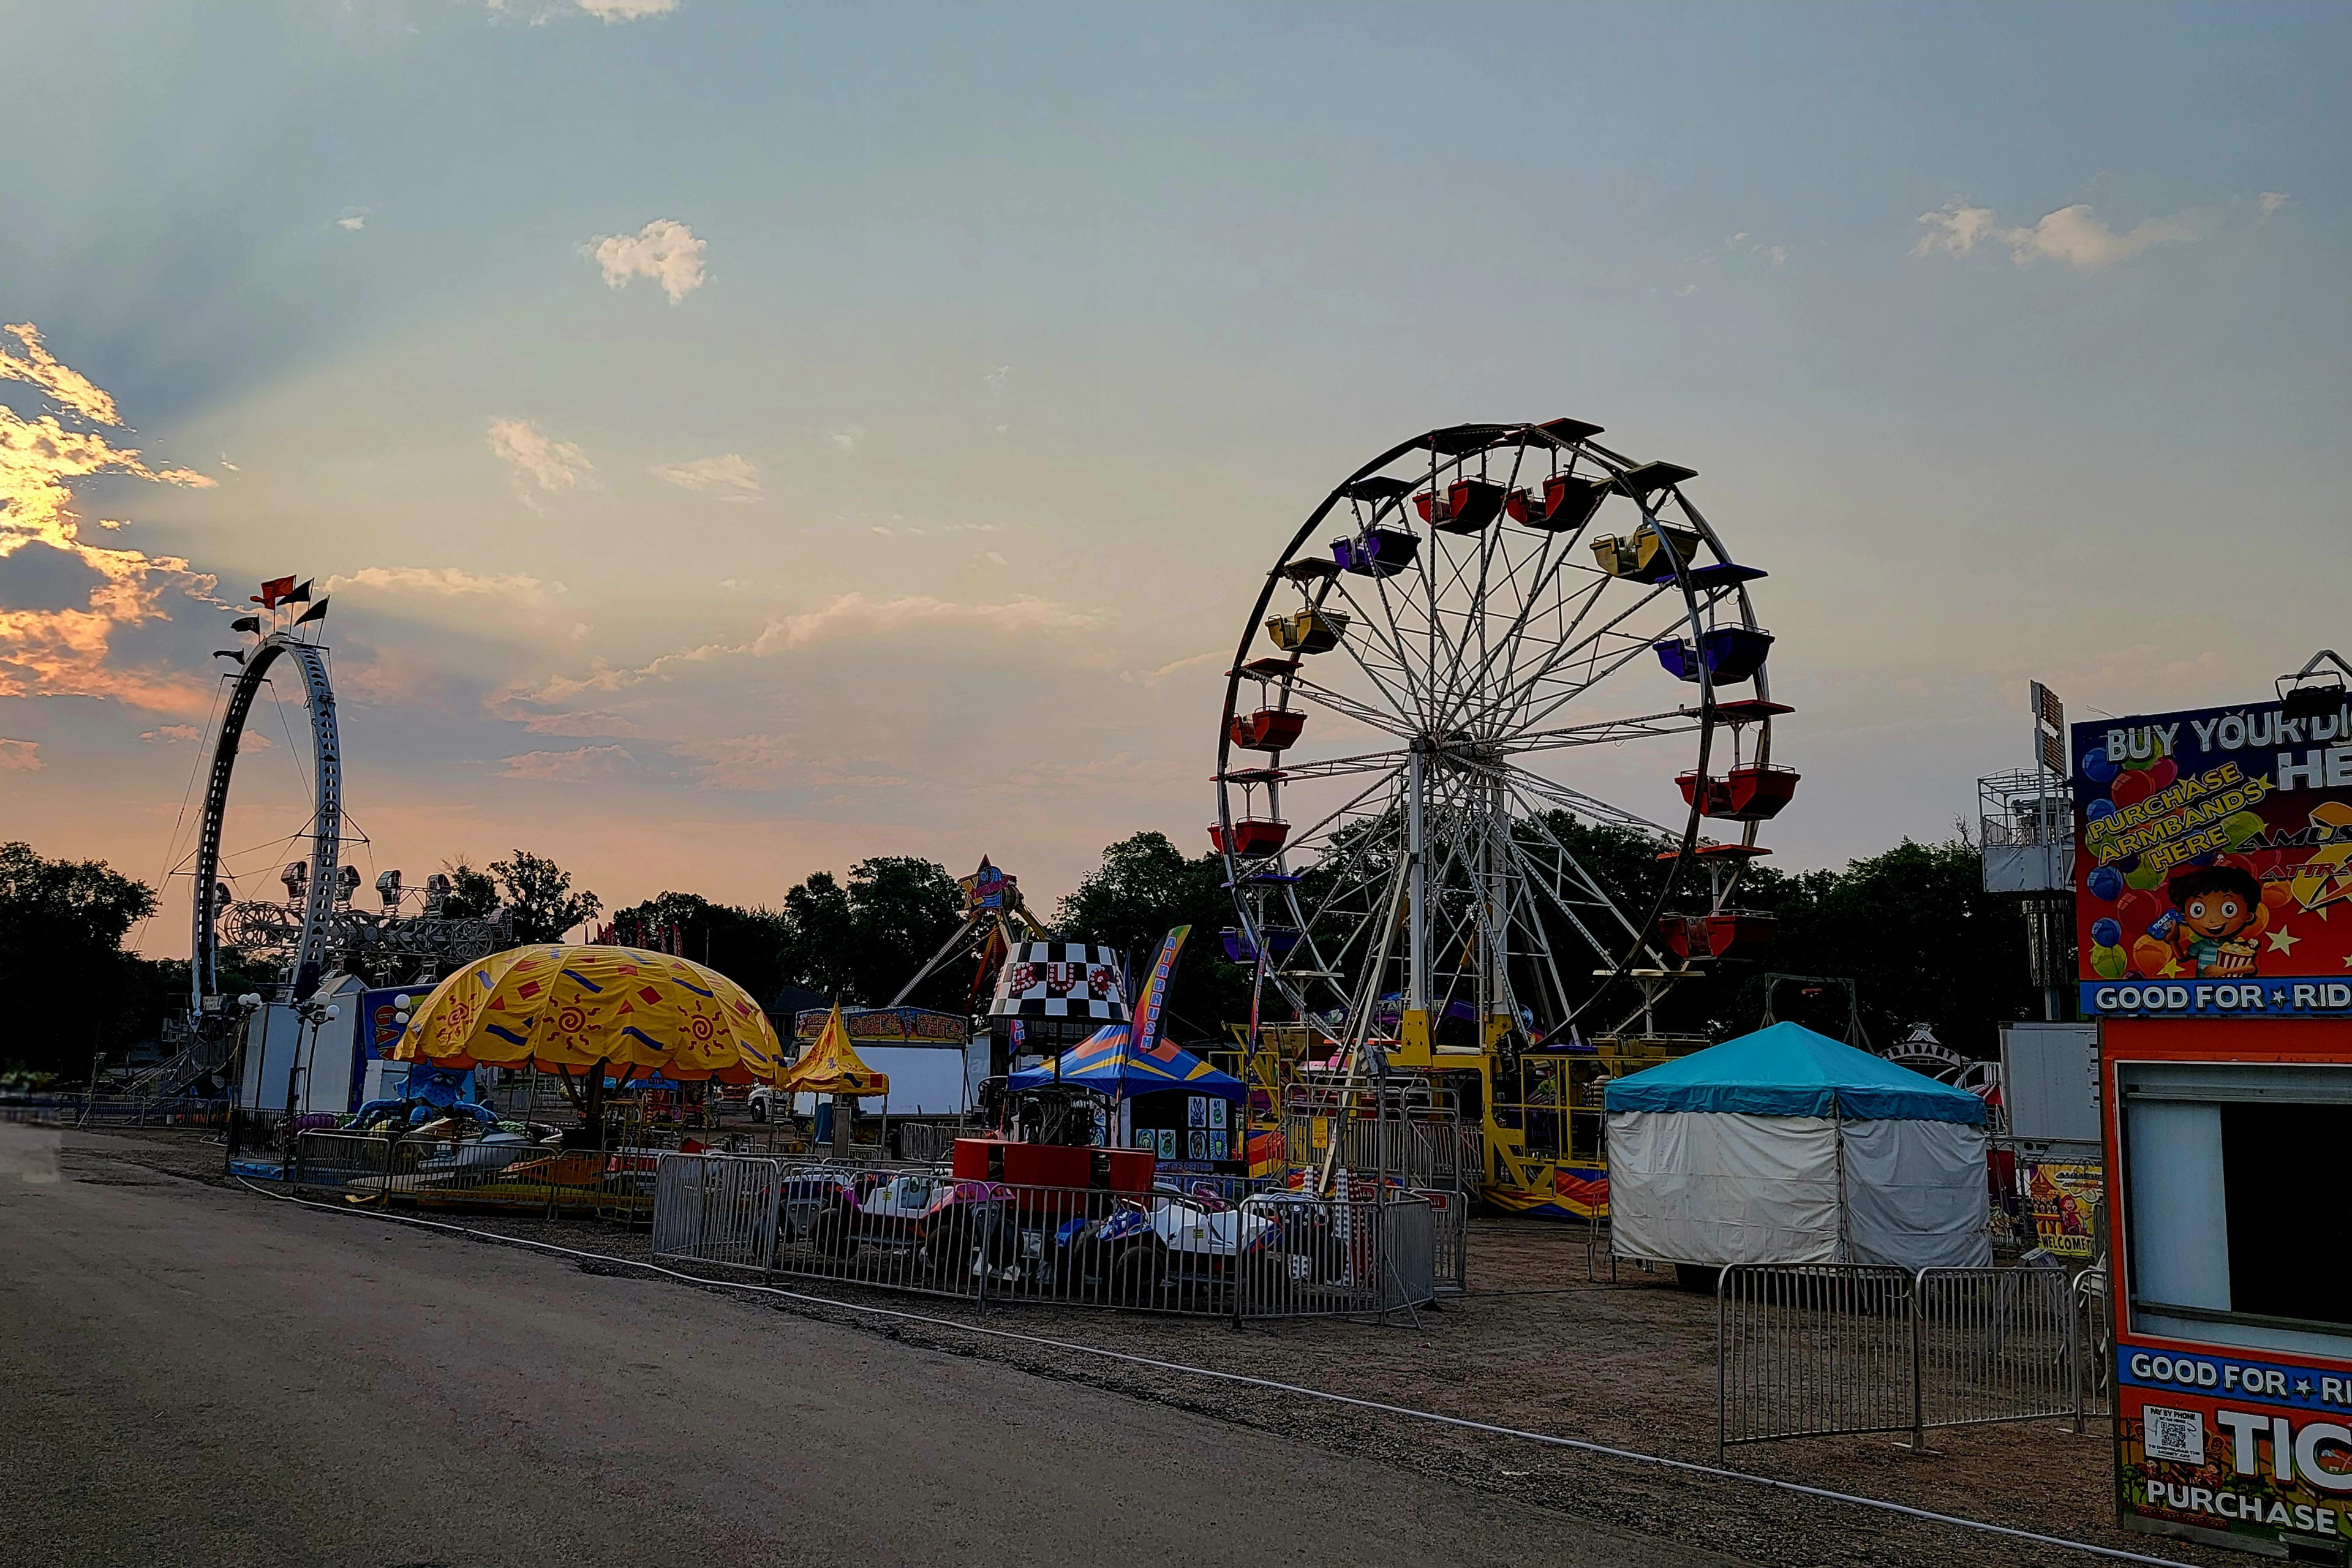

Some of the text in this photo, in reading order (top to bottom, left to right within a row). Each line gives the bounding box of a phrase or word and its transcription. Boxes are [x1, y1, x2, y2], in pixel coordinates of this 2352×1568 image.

[2107, 704, 2352, 761] BUY YOUR DI
[2277, 746, 2352, 791] HE
[2087, 763, 2242, 841] PURCHASE
[2100, 782, 2265, 865] ARMBANDS
[2149, 825, 2230, 870] HERE
[2152, 913, 2171, 930] TICKET
[1140, 937, 1176, 1049] AIRBRUSH
[2096, 984, 2351, 1009] GOOD FOR RID
[1882, 1044, 1955, 1060] TRABANT
[2042, 1235, 2087, 1251] WELCOME
[2132, 1354, 2352, 1404] GOOD FOR RI
[2150, 1408, 2162, 1416] PAY
[2174, 1411, 2196, 1421] PHONE
[2218, 1410, 2352, 1490] TIC
[2147, 1480, 2337, 1535] PURCHASE
